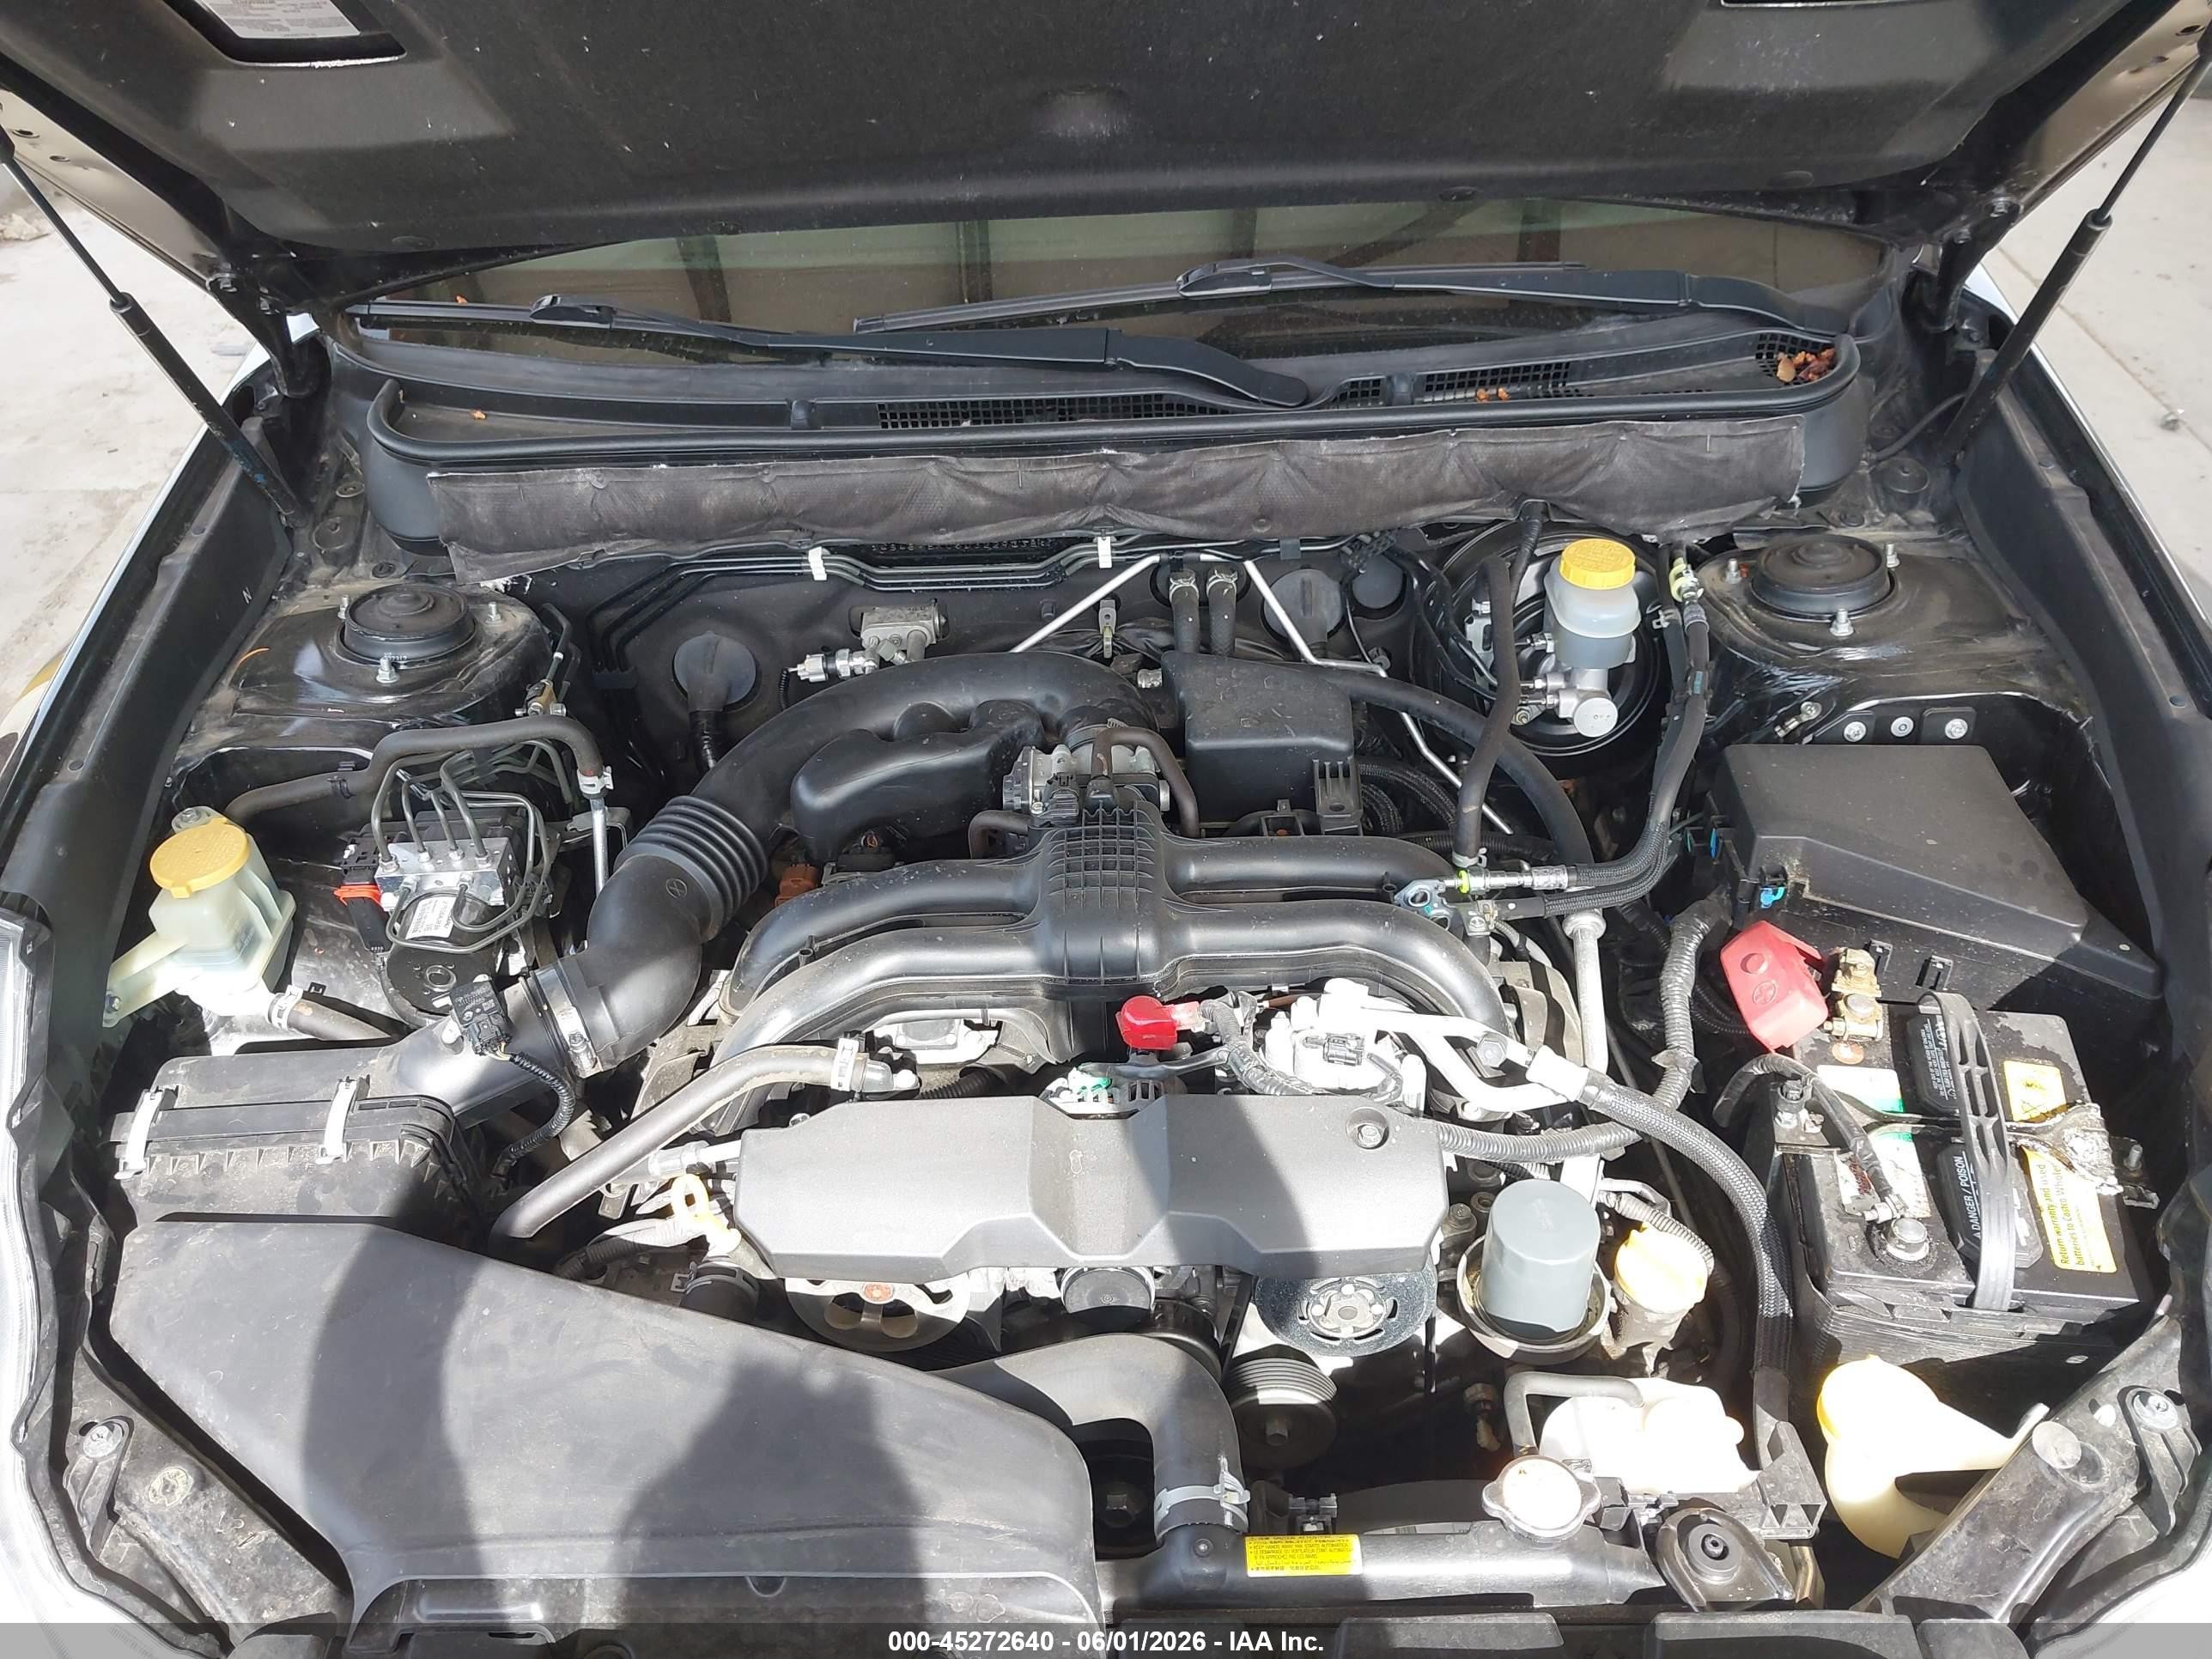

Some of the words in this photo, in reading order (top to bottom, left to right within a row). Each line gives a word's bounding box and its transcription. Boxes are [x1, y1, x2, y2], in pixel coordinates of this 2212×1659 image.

[1954, 1156, 1969, 1188] POISON
[2036, 1164, 2048, 1185] used
[2039, 1188, 2051, 1202] and
[2059, 1198, 2072, 1221] Costco
[1964, 1195, 1980, 1231] DANGER
[2046, 1204, 2062, 1237] warranty
[2057, 1238, 2069, 1264] Return
[2069, 1232, 2084, 1266] batteries
